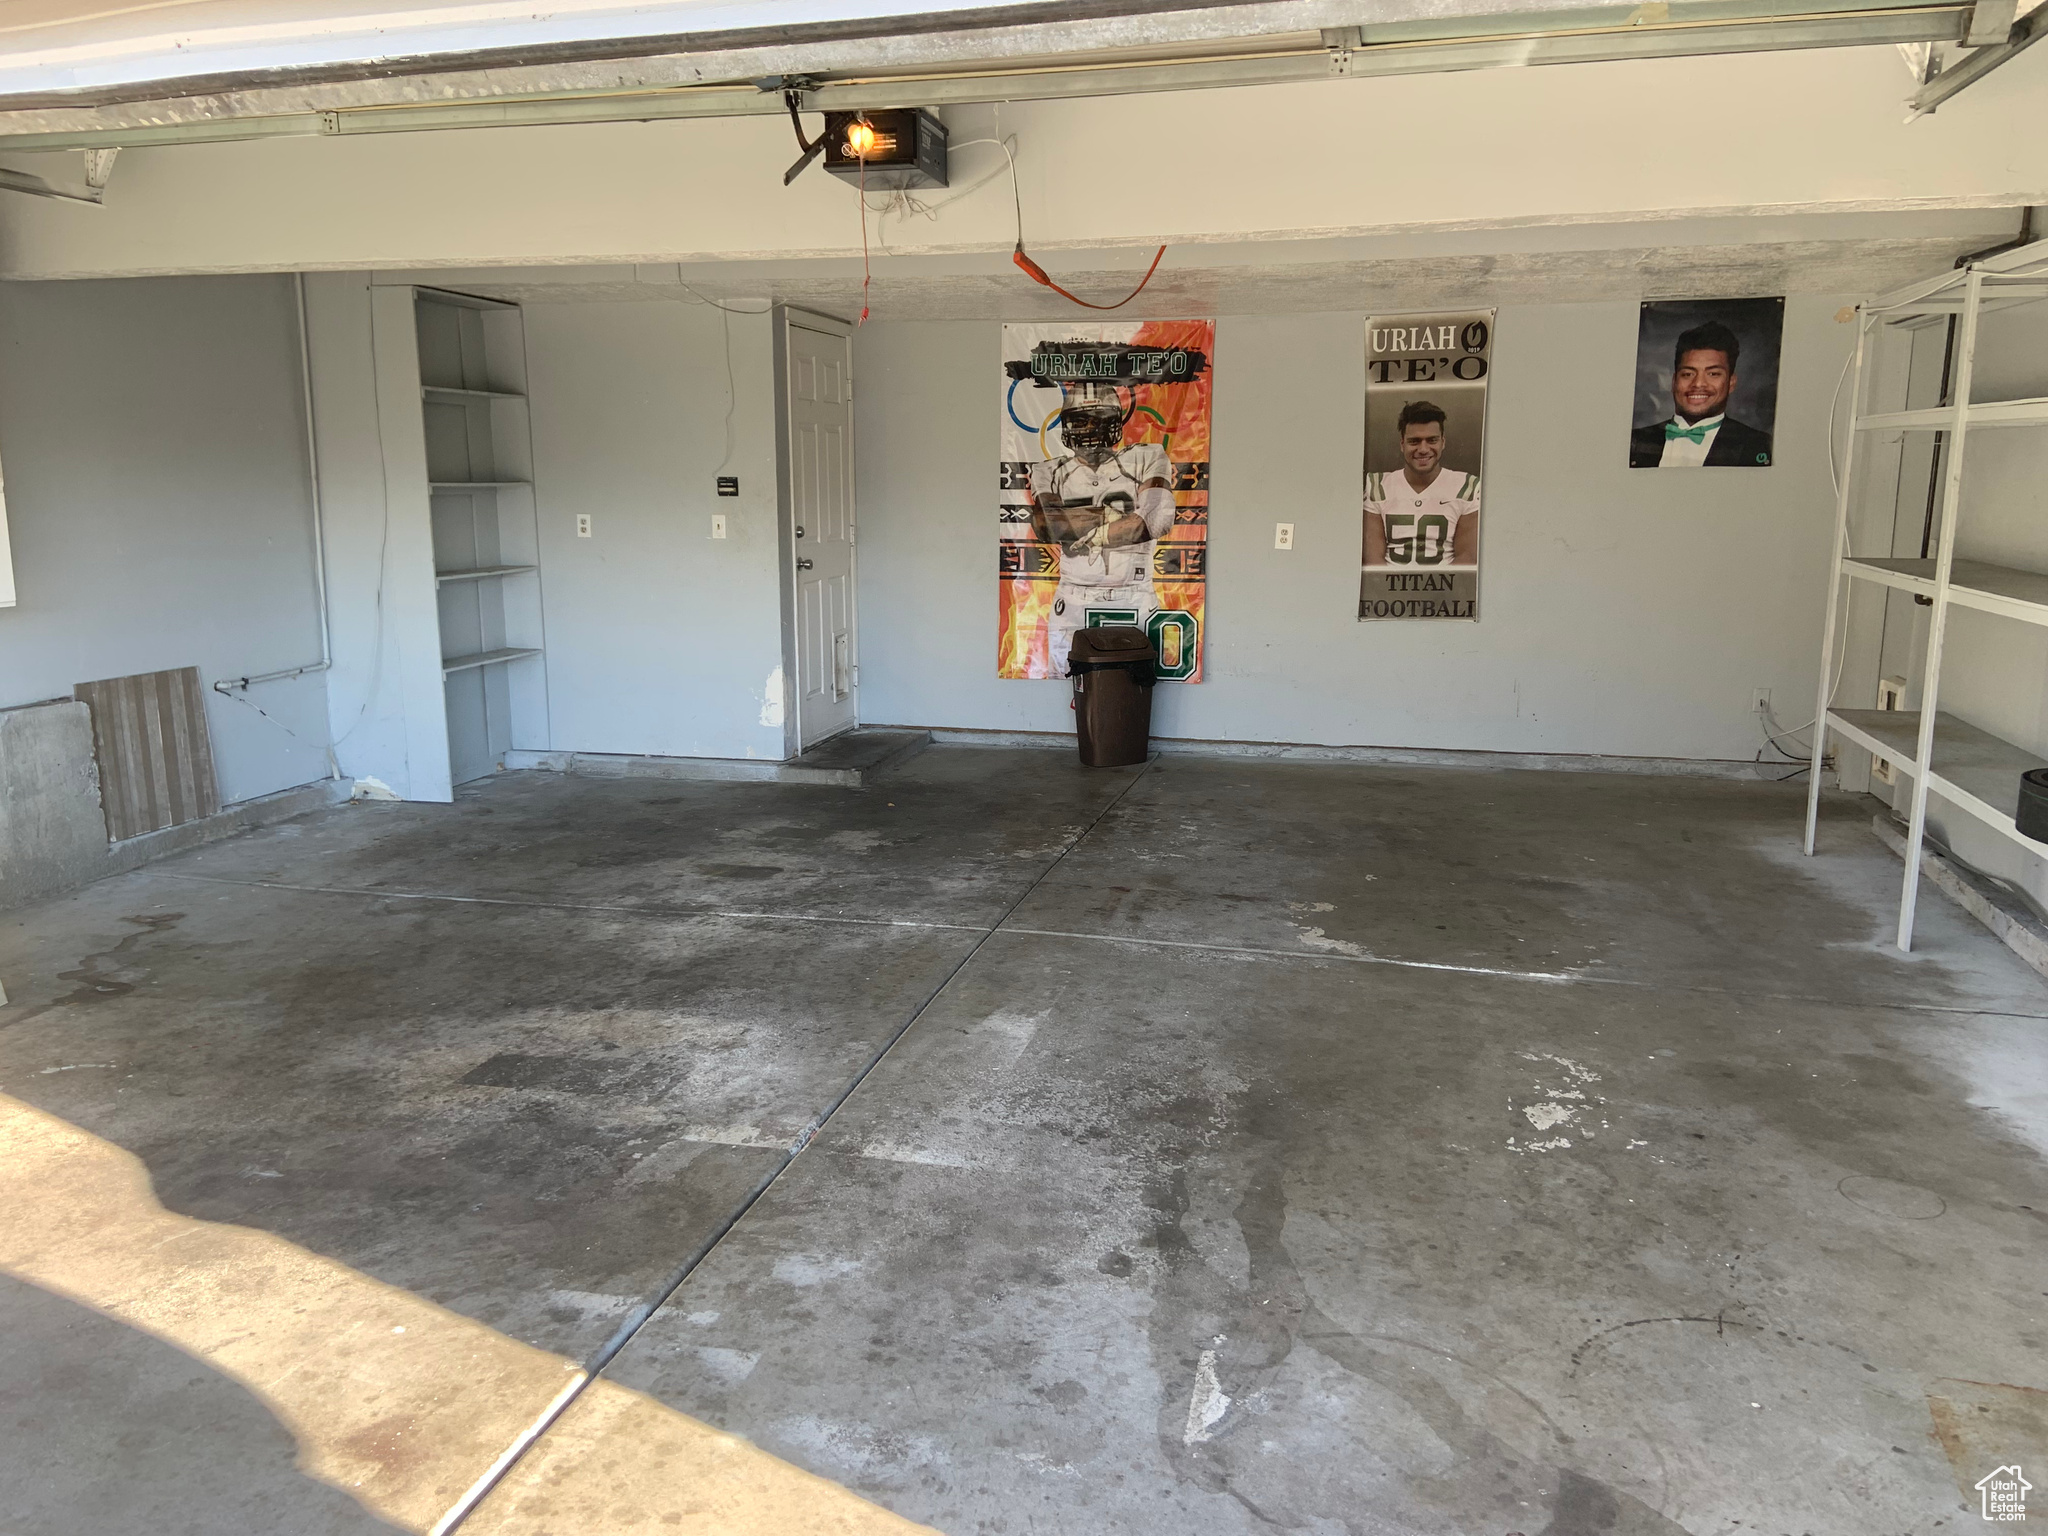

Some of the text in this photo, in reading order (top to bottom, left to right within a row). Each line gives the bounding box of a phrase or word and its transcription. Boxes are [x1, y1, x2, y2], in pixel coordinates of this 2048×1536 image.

[1371, 325, 1457, 353] URIAH
[1031, 351, 1188, 376] URIAH TE'O
[1369, 356, 1488, 383] TE'O
[1385, 514, 1449, 565] 50
[1386, 573, 1456, 591] TITAN
